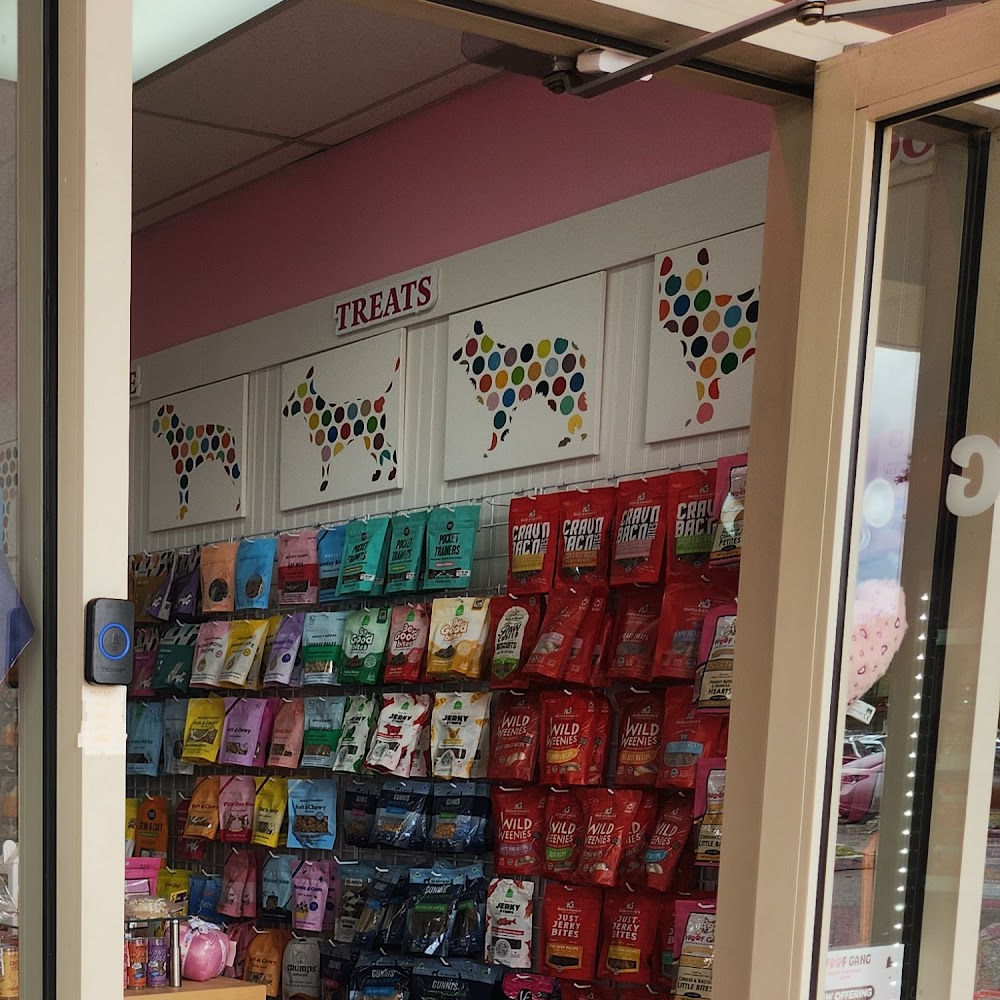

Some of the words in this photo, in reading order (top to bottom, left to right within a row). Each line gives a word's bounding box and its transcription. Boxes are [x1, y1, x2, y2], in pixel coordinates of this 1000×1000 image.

[336, 275, 432, 332] TREATS
[440, 620, 469, 636] Good
[351, 633, 373, 645] Good
[394, 629, 418, 641] Good
[389, 713, 413, 721] JERKY
[502, 711, 530, 729] WILD
[550, 717, 579, 736] WILD
[626, 716, 659, 737] WILD
[620, 734, 658, 747] WEENIES
[501, 811, 532, 830] WILD
[587, 816, 614, 835] WILD
[498, 827, 532, 841] WEENIES
[495, 903, 521, 911] JERKY
[557, 914, 579, 922] JUST
[617, 916, 638, 924] JUST
[552, 921, 581, 930] JERKY
[612, 922, 640, 932] JERKY
[551, 929, 579, 938] BITES
[849, 954, 871, 966] GANG
[678, 982, 694, 990] LITTLE
[834, 988, 873, 1000] OFFERING
